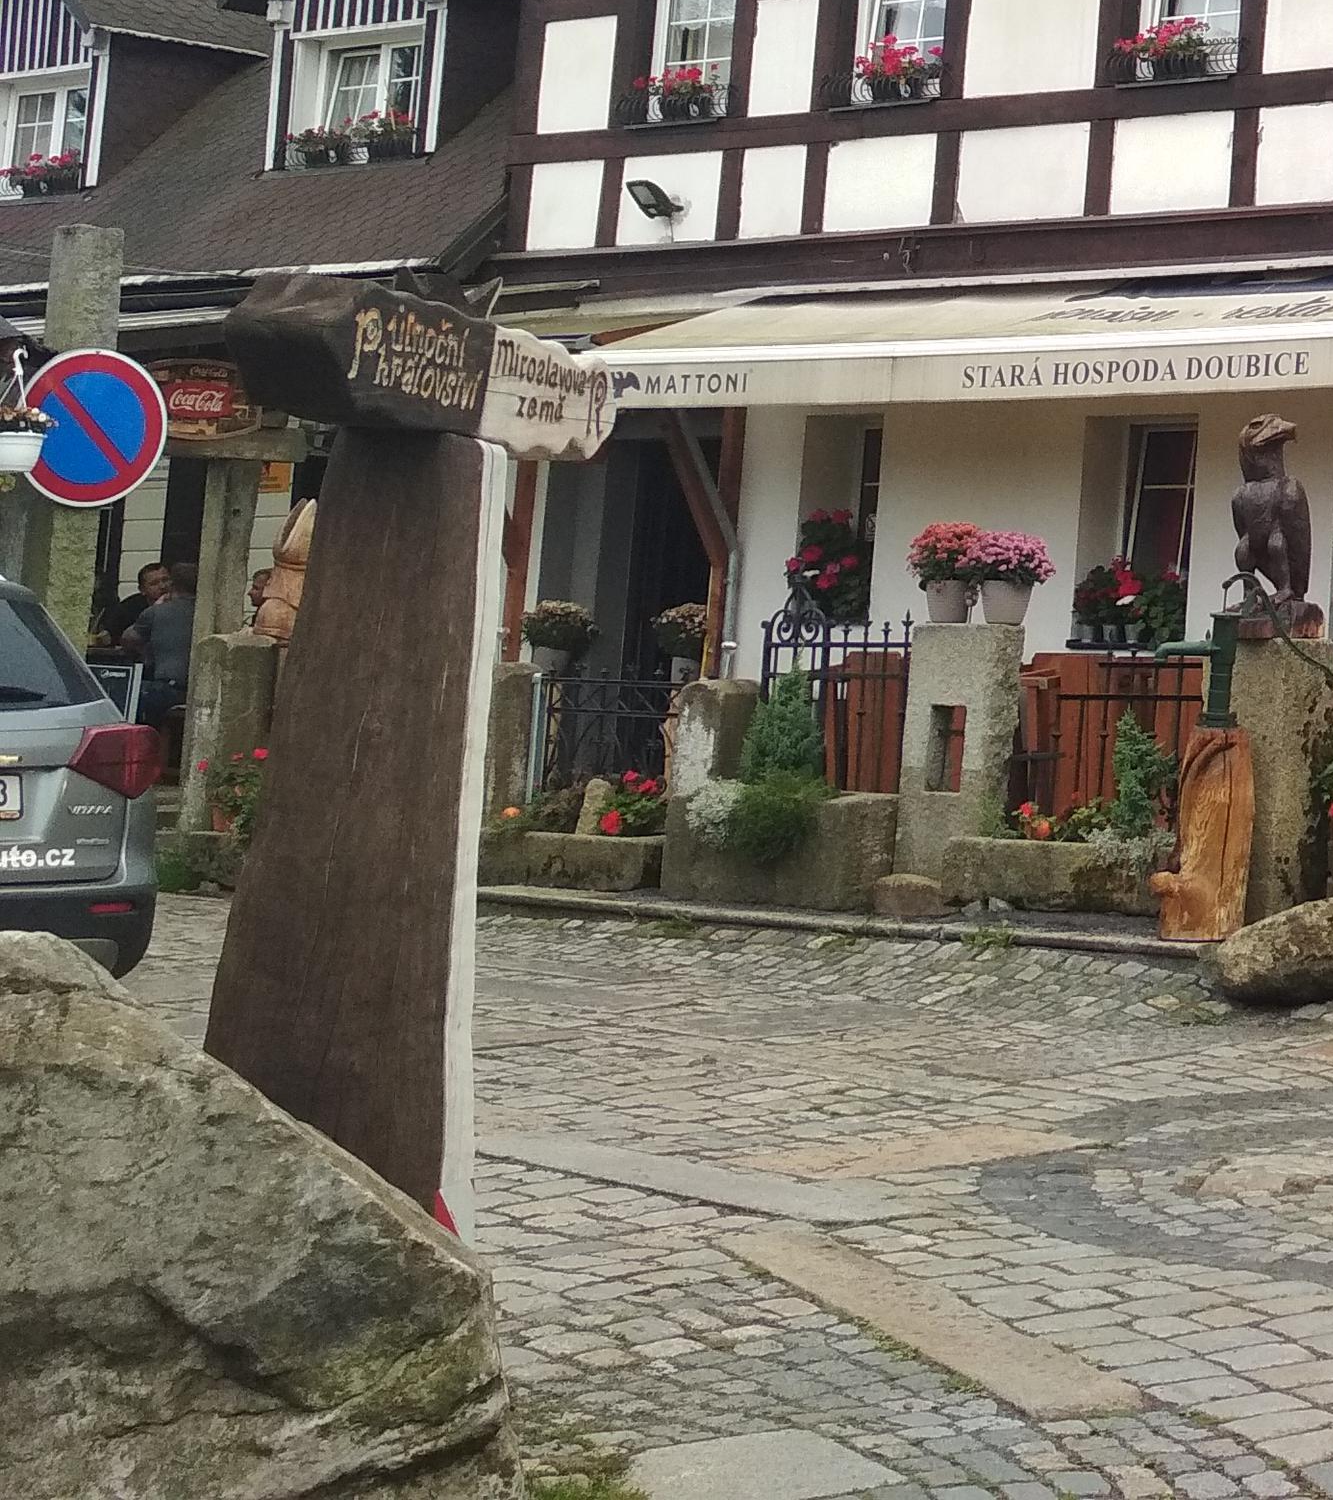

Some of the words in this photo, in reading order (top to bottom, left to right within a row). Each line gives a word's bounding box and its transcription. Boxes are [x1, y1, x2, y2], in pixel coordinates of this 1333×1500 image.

[645, 373, 748, 394] MATTONI
[962, 356, 1042, 389] STARÁ
[1052, 357, 1177, 386] HOSPODA
[1185, 351, 1310, 381] DOUBICE
